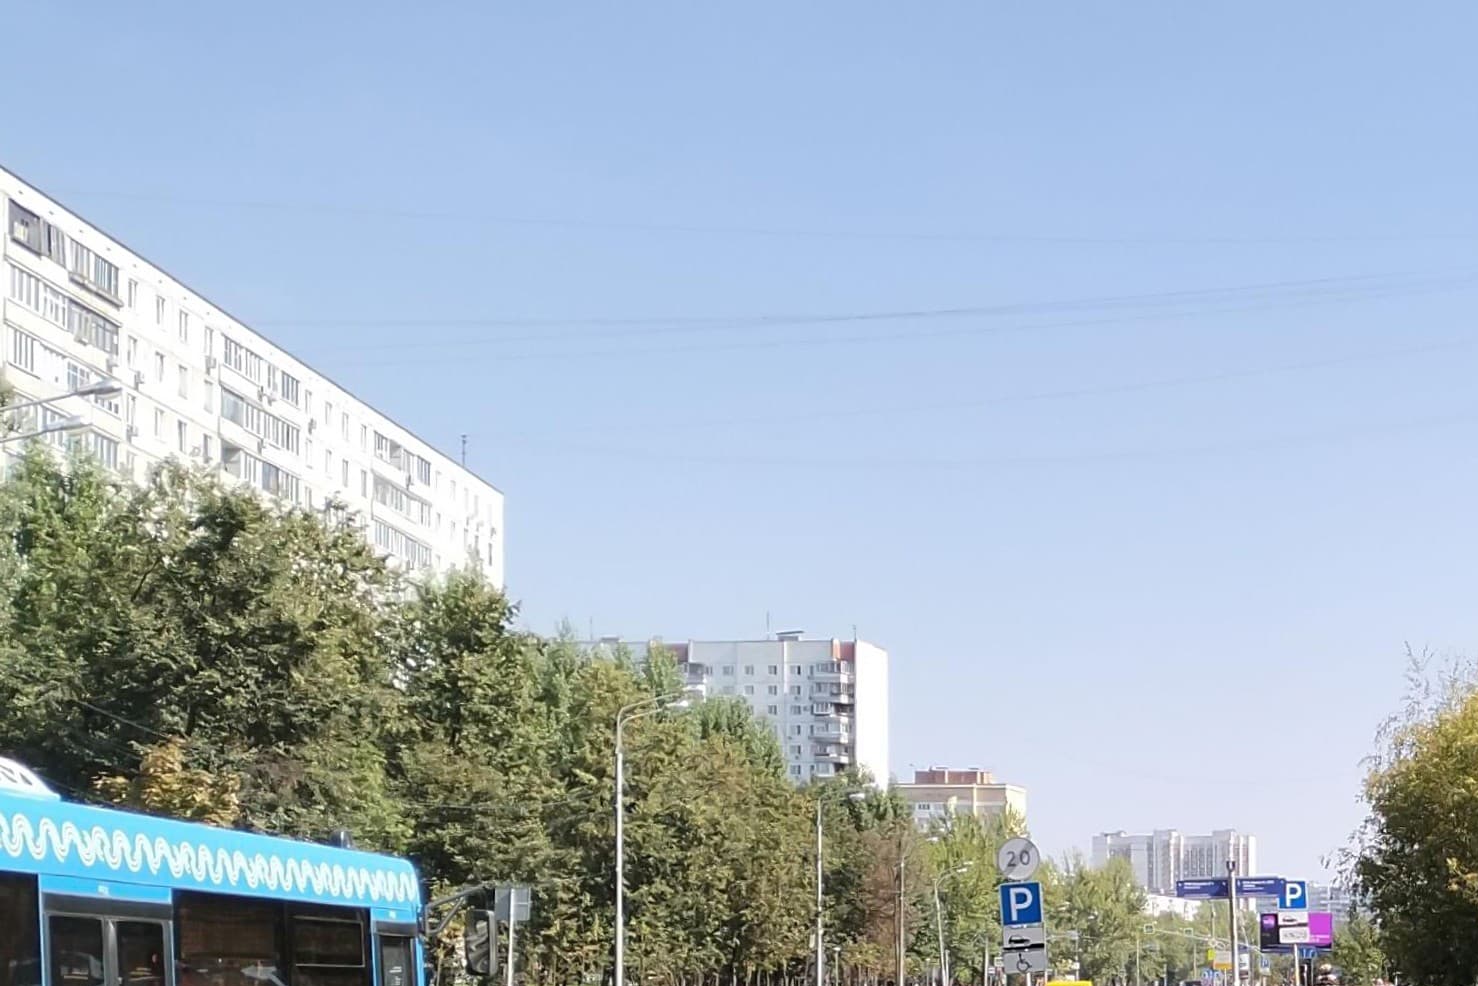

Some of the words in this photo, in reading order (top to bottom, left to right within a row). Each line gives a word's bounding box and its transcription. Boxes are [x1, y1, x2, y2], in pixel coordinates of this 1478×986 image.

[1007, 850, 1031, 867] 20
[1009, 887, 1033, 921] P
[1286, 883, 1302, 907] P
